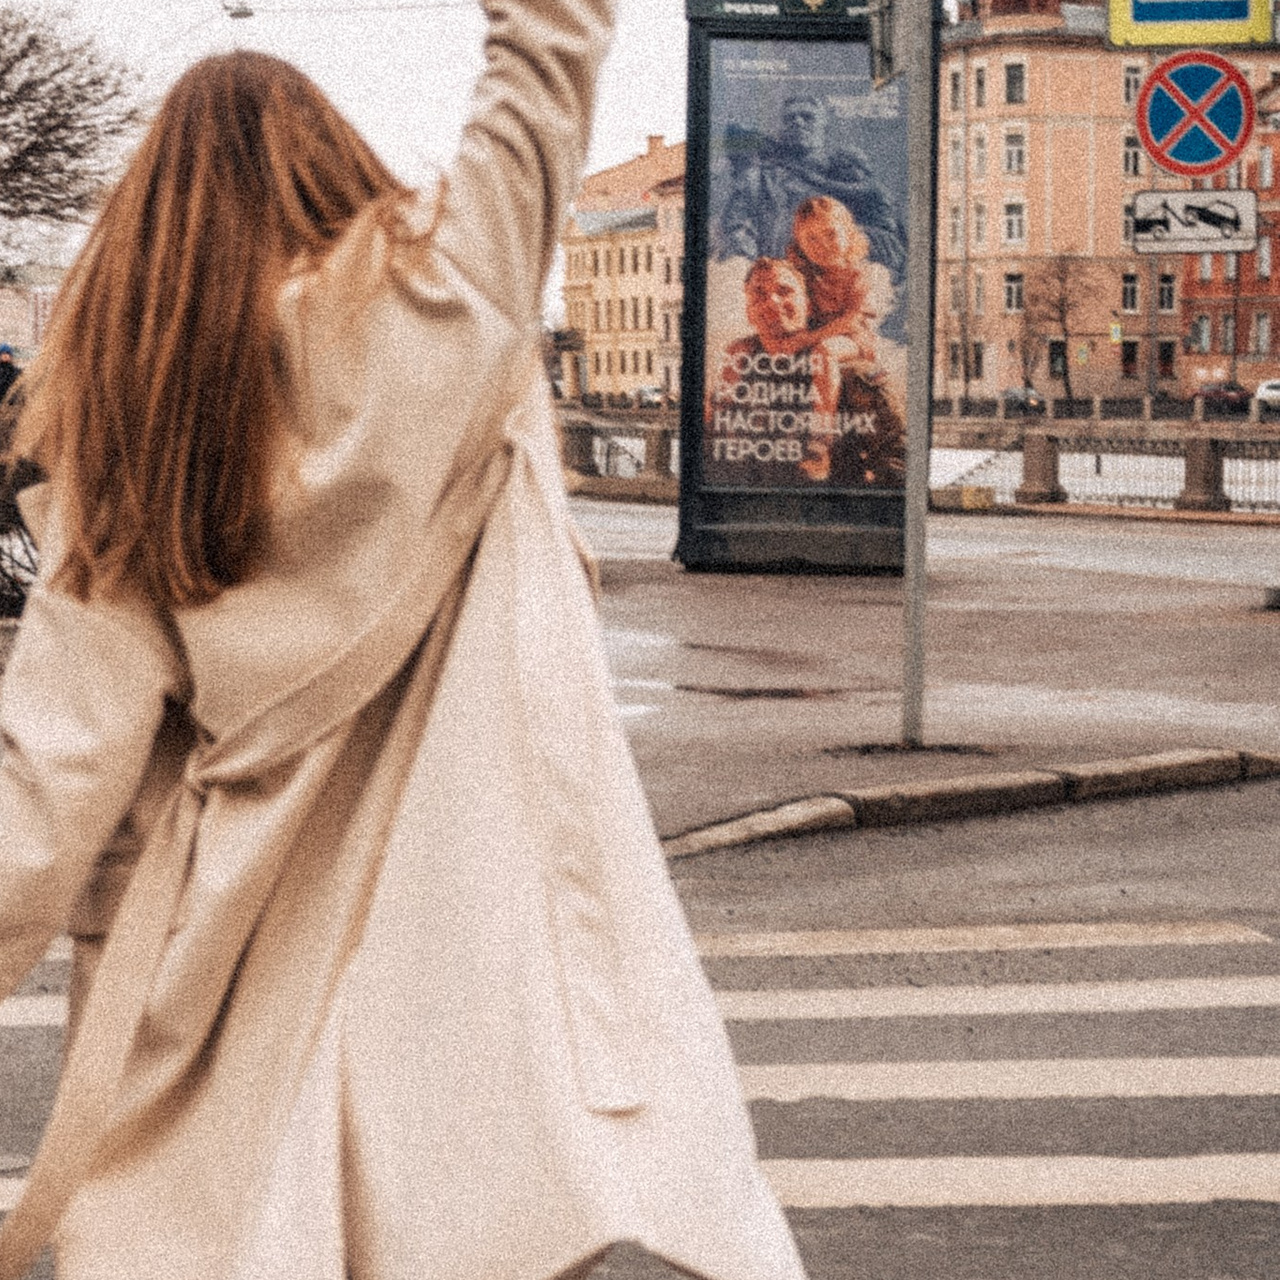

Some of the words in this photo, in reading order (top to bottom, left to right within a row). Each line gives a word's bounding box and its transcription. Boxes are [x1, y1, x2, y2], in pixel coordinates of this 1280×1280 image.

[716, 382, 823, 405] РОДИНА
[713, 410, 876, 436] НАСТОЯЩИХ
[712, 439, 803, 462] ГЕРОЕВ
